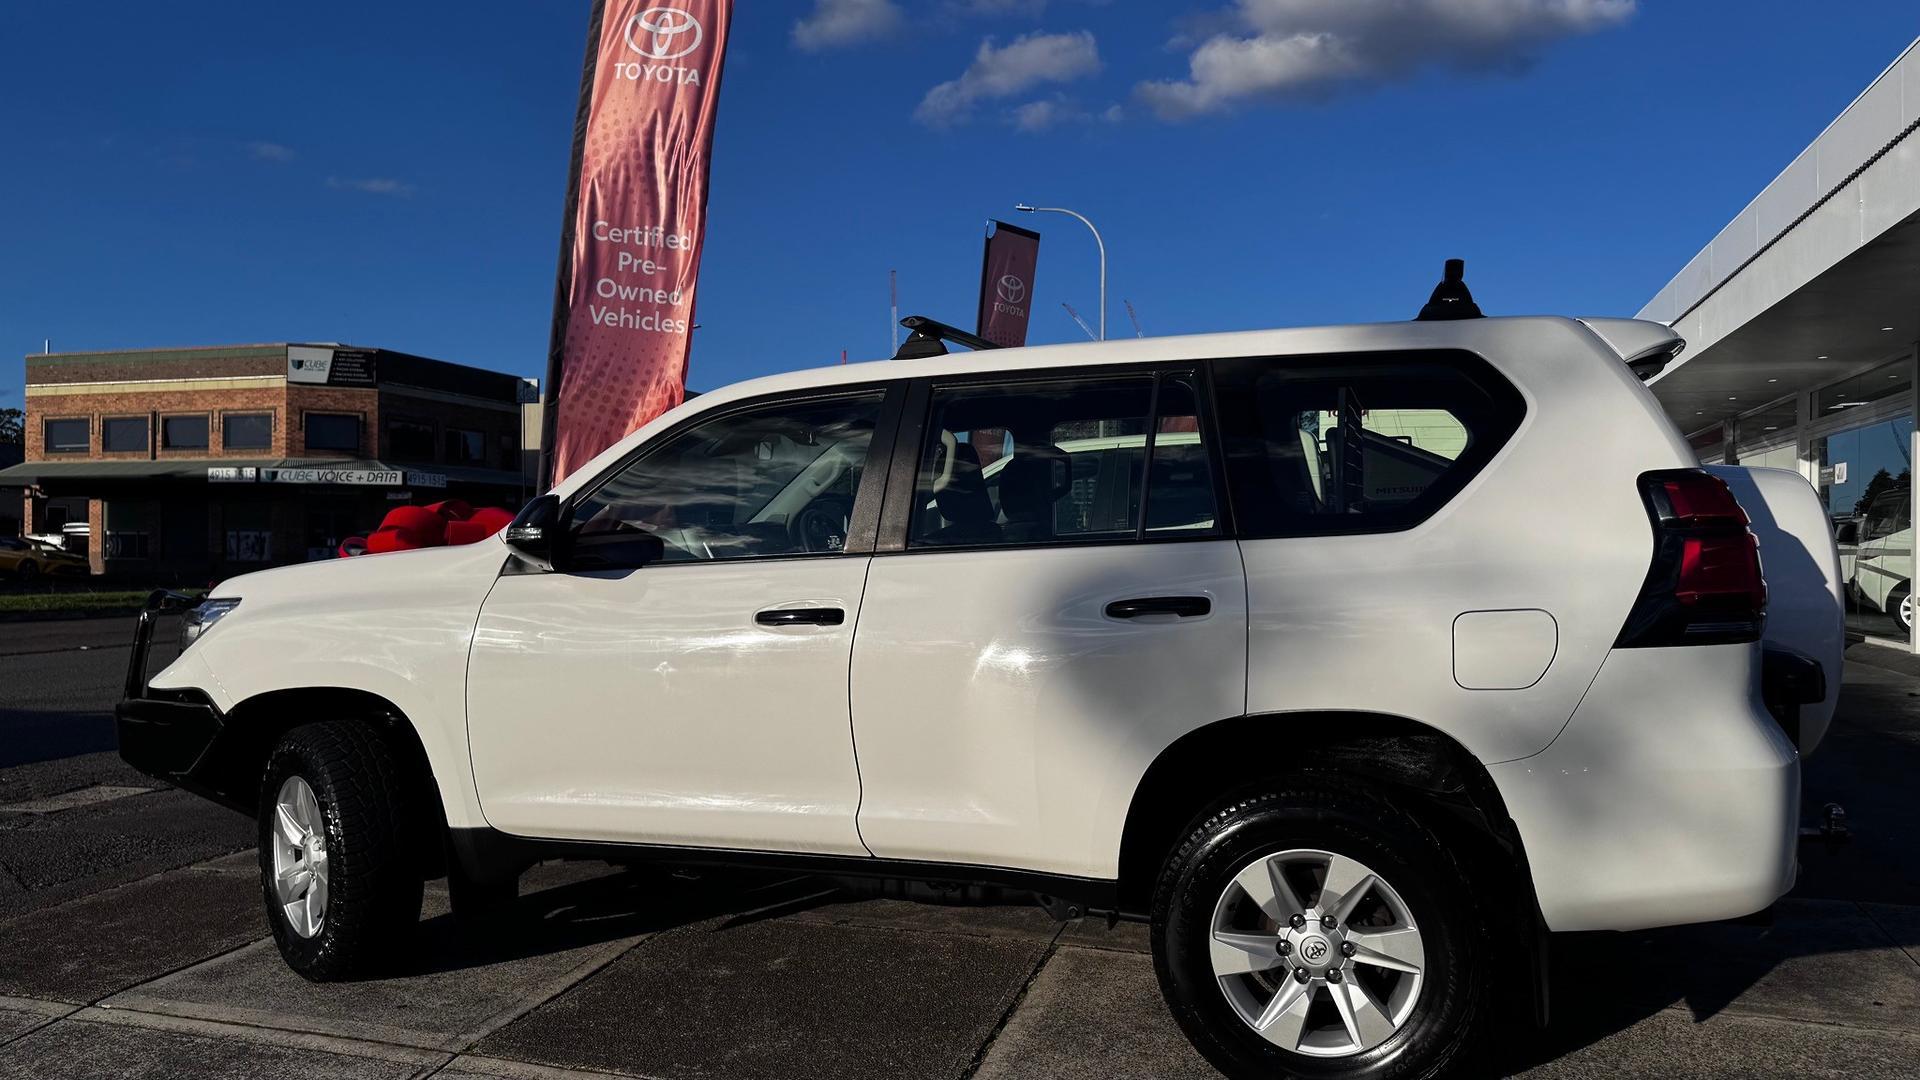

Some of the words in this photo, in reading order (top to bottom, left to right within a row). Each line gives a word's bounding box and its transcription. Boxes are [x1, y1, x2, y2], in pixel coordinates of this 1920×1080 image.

[614, 62, 701, 87] TOYOTA
[592, 220, 691, 251] Certified
[618, 251, 667, 275] Pre-
[596, 278, 683, 306] Owned
[589, 304, 686, 333] Vehicles
[993, 302, 1024, 318] TOYOTA
[304, 359, 328, 369] CUBE
[209, 469, 231, 481] 4915
[281, 470, 313, 481] CUBE
[317, 470, 354, 482] VOICE
[366, 471, 398, 483] DATA
[408, 472, 426, 484] 4915
